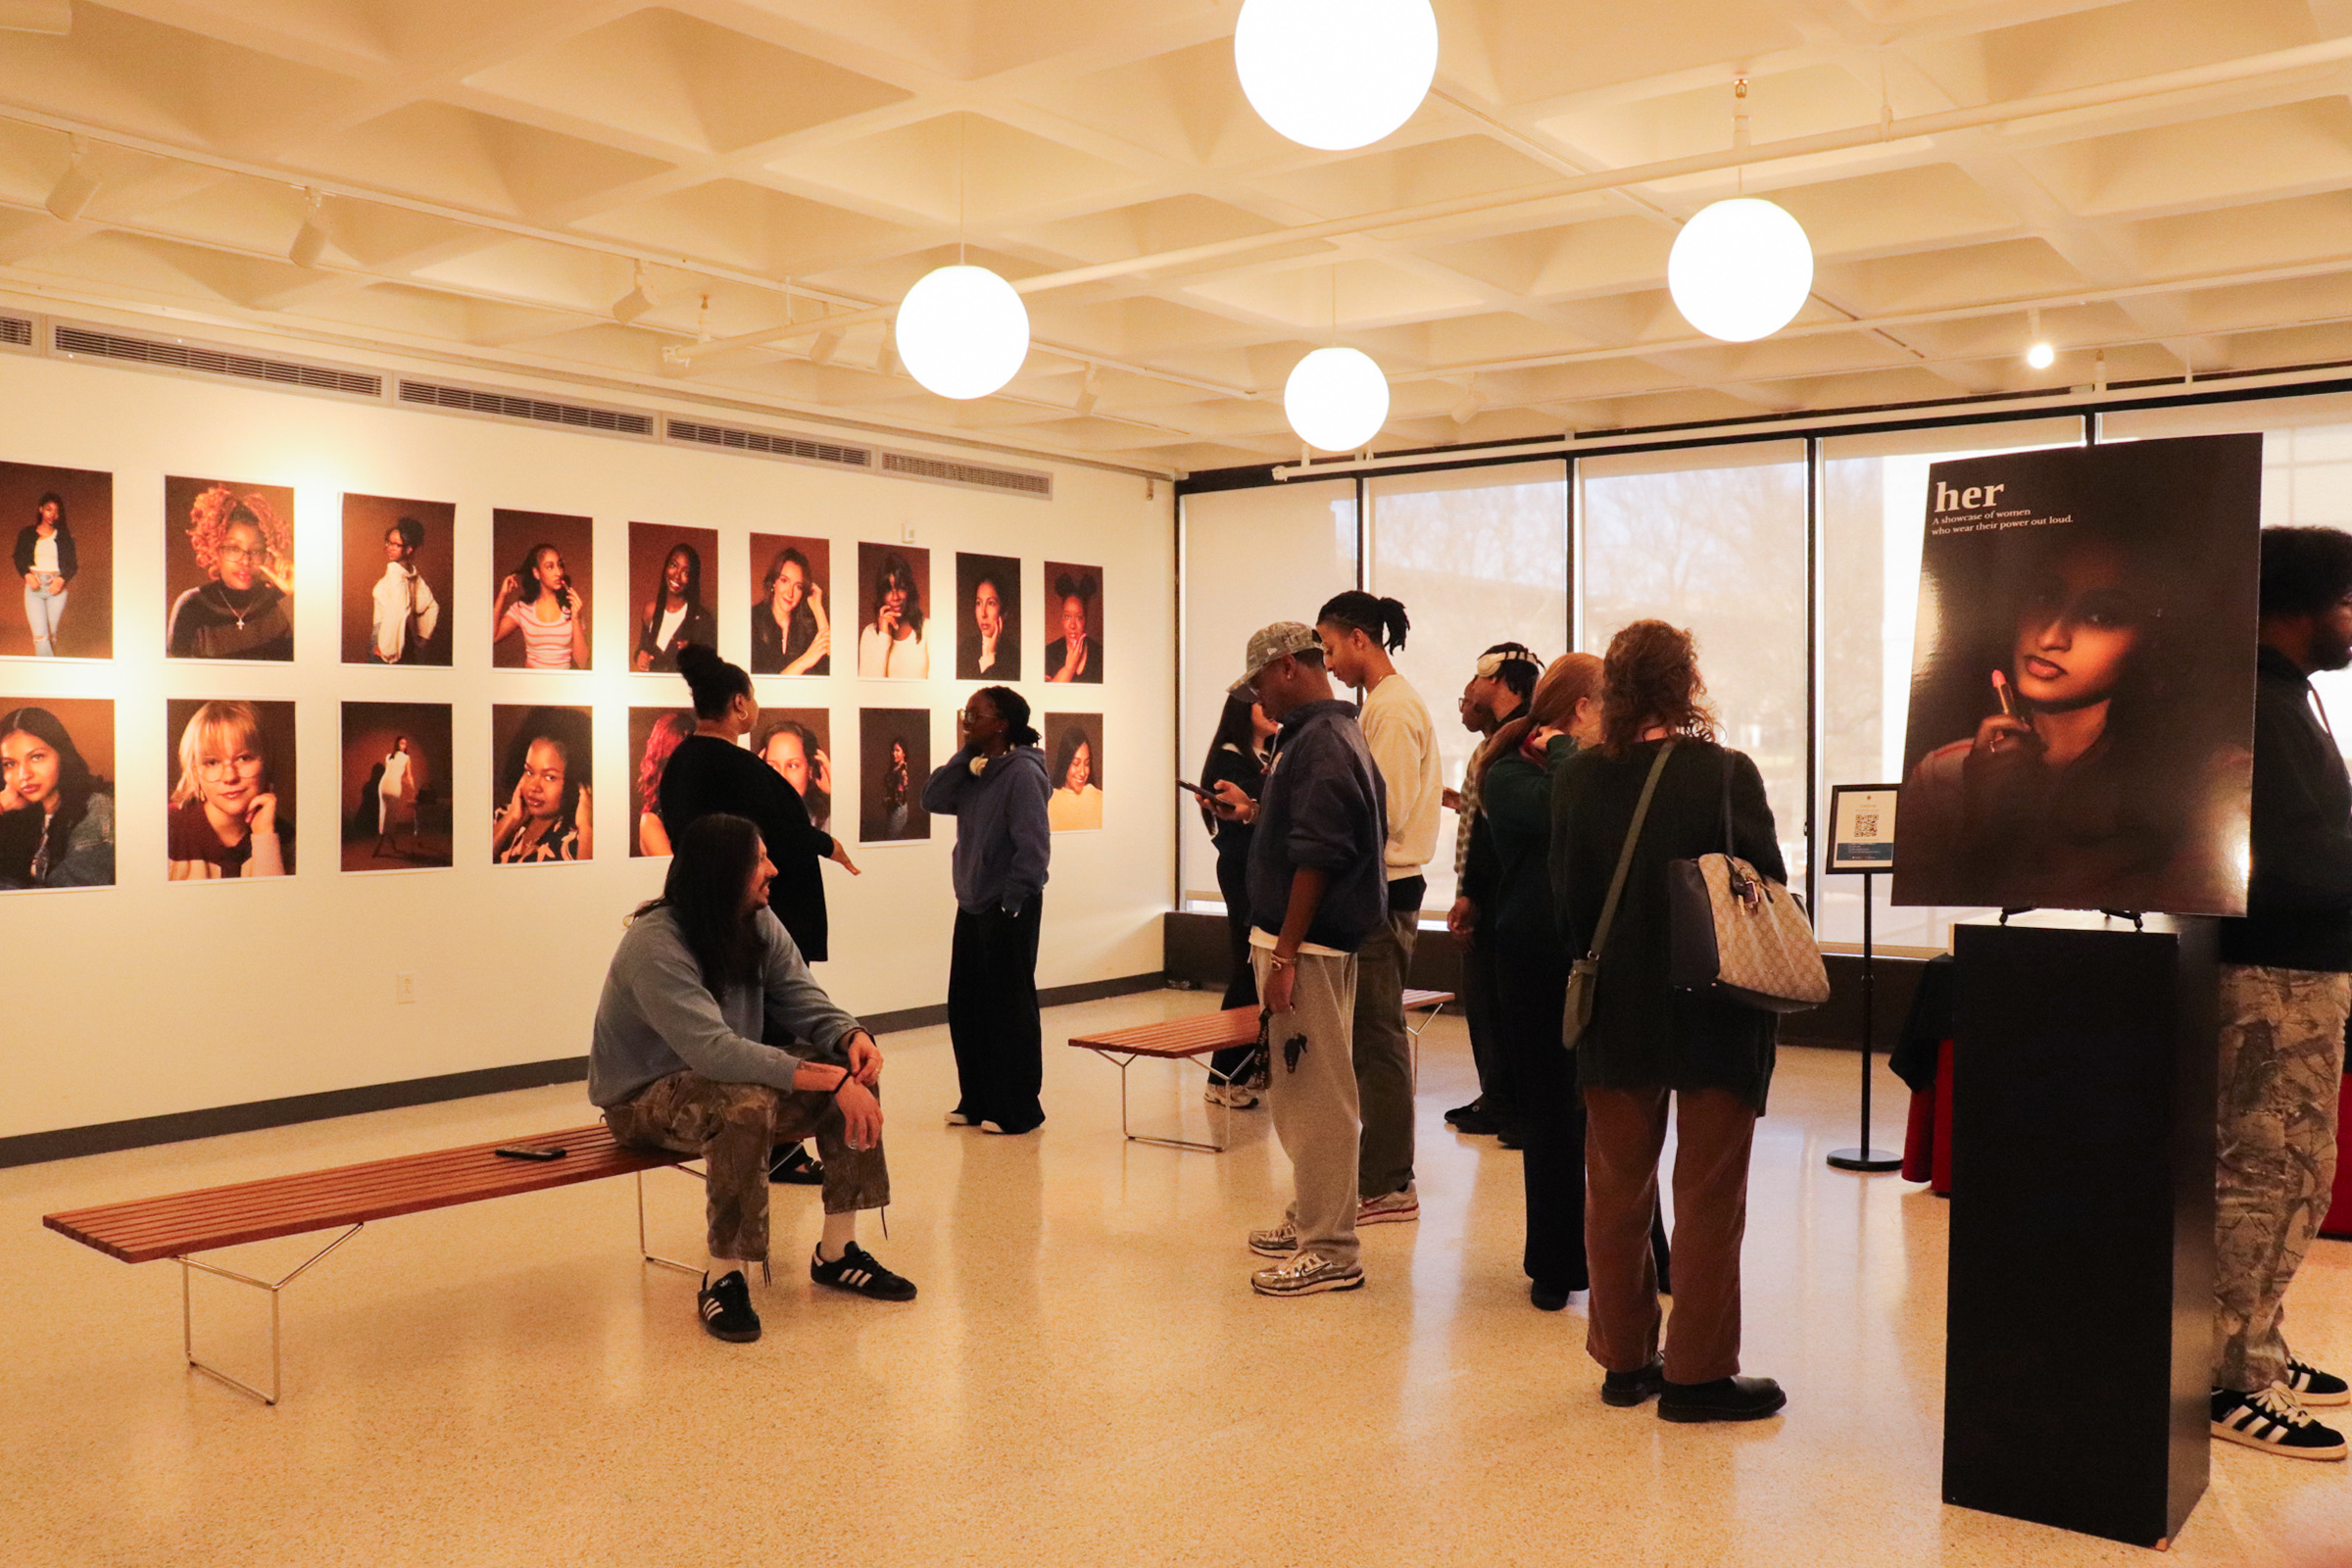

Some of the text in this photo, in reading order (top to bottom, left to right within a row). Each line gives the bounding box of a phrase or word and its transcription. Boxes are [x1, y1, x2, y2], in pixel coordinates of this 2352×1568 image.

[1934, 481, 2004, 513] her
[1932, 526, 1951, 535] who
[1976, 521, 1997, 531] their
[1999, 519, 2029, 530] power
[2049, 514, 2074, 524] loud.
[1941, 514, 1982, 524] showcase
[1984, 511, 1995, 519] of
[1995, 509, 2031, 518] women
